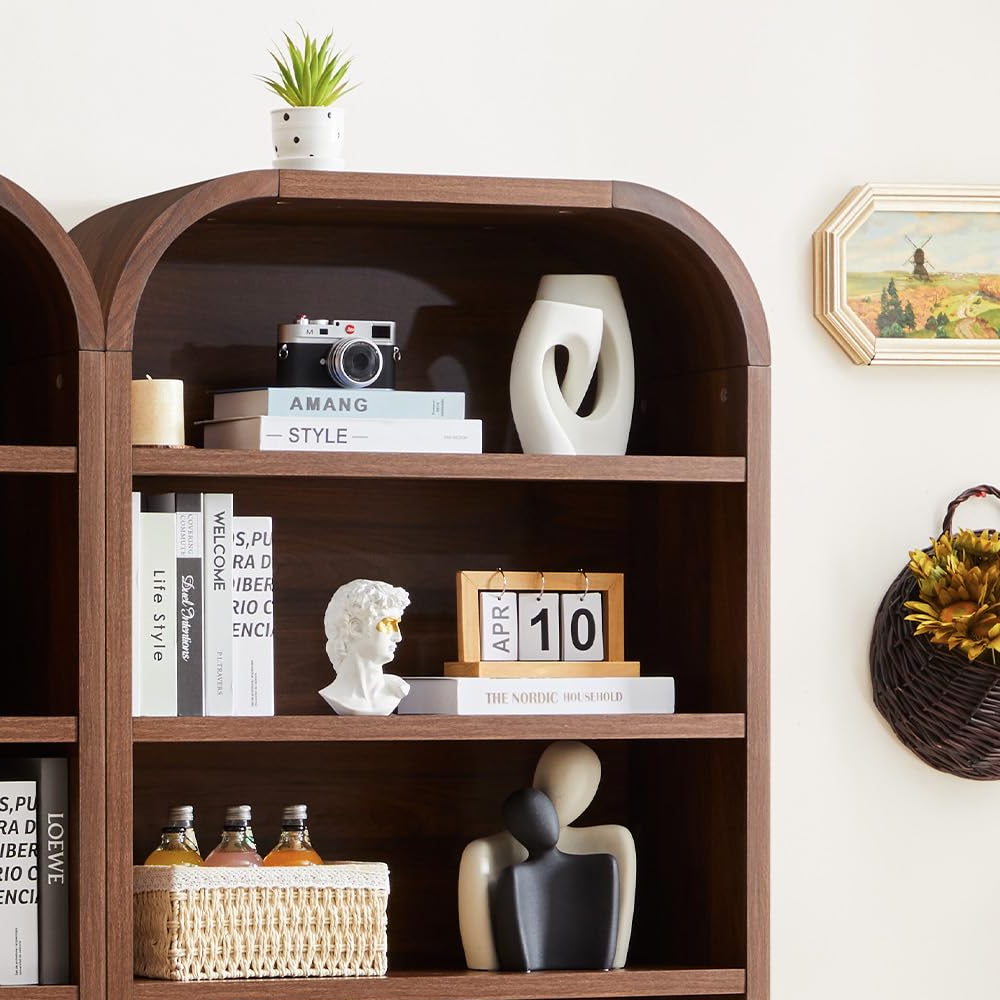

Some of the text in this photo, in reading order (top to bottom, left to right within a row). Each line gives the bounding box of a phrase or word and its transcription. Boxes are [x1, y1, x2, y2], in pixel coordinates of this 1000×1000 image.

[290, 396, 368, 412] AMANG
[289, 427, 348, 444] STYLE
[233, 531, 271, 549] S,PU
[213, 510, 225, 591] WELCOME
[233, 577, 273, 592] IBER
[151, 570, 166, 662] Life Style
[233, 622, 273, 637] ENCI
[492, 605, 510, 653] APR
[486, 691, 624, 705] THE NORDIC HOUSEHOLD
[47, 812, 65, 885] LOEWE
